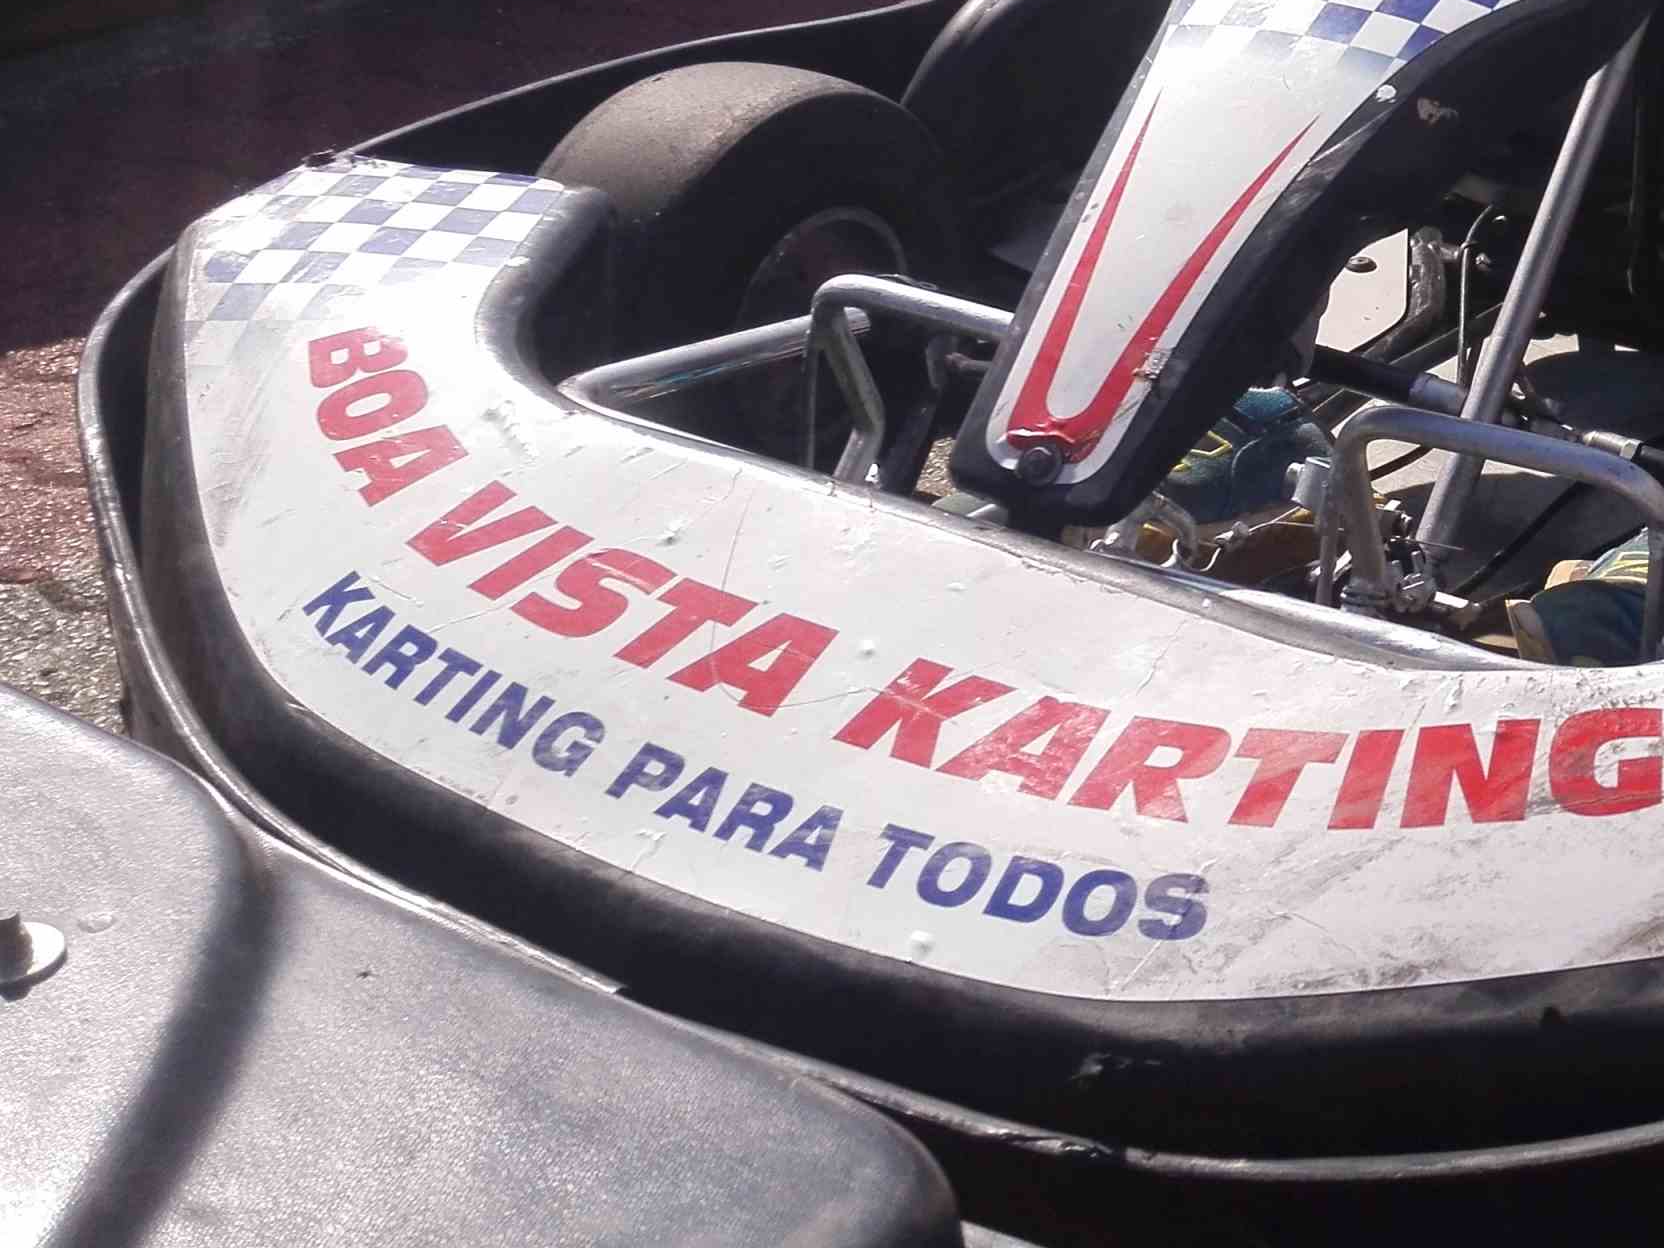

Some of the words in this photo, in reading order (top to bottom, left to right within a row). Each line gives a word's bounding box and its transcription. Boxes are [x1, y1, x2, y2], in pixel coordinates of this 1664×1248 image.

[301, 570, 606, 777] KARTING
[605, 742, 844, 873] PARA
[867, 824, 1211, 941] TODOS
[308, 326, 469, 508] BOA
[406, 480, 839, 718] VISTA
[833, 658, 1664, 831] KARTING
